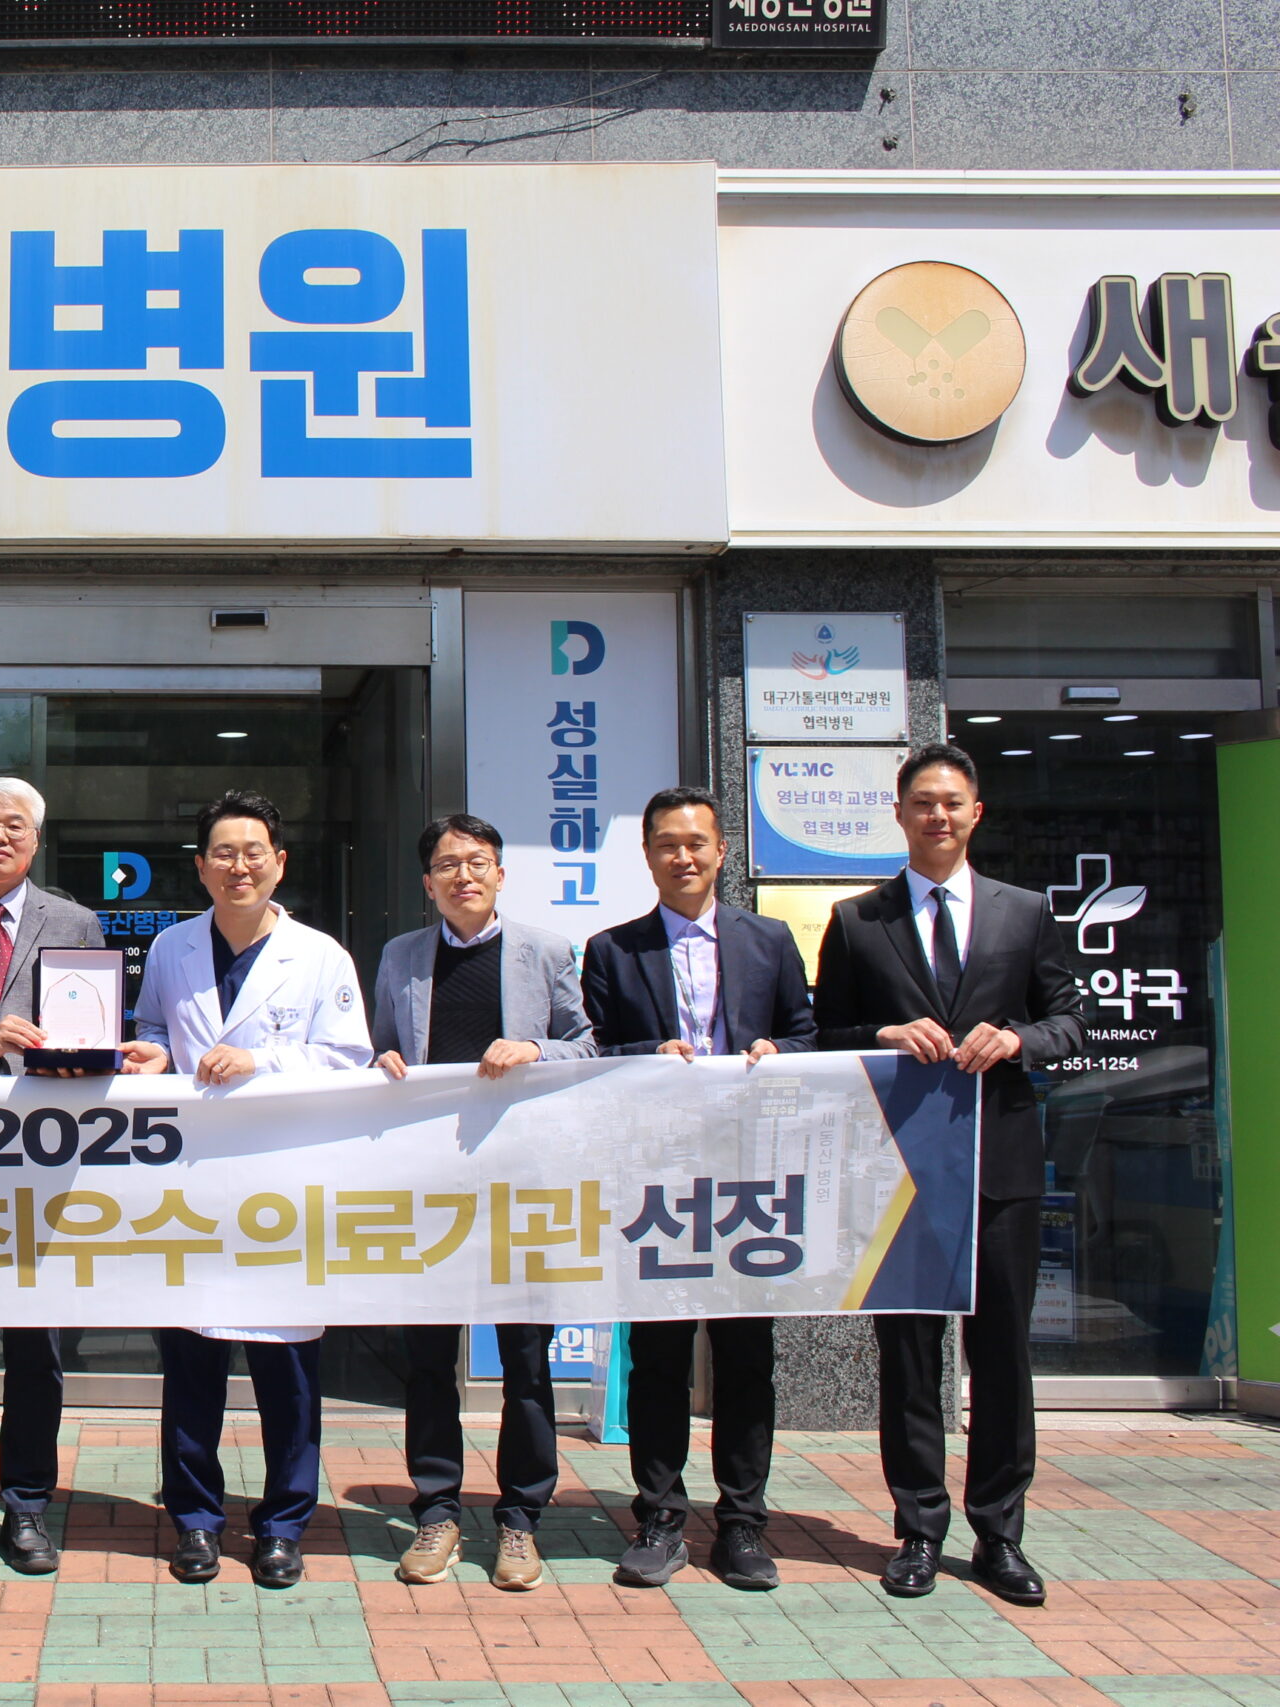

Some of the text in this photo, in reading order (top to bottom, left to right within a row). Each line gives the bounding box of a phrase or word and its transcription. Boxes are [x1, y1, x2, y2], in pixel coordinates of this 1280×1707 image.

[728, 23, 872, 33] SAEDONGSAN HOSPITAL
[763, 690, 892, 706] 대구가톨릭대학교병원
[803, 715, 855, 731] 협력병원
[546, 701, 600, 905] 성실하고
[776, 789, 894, 806] 영남대학교병원
[803, 820, 869, 836] 협력병원
[95, 910, 178, 935] 동산병원
[235, 1179, 612, 1286] 의료기관
[620, 1174, 806, 1281] 선정
